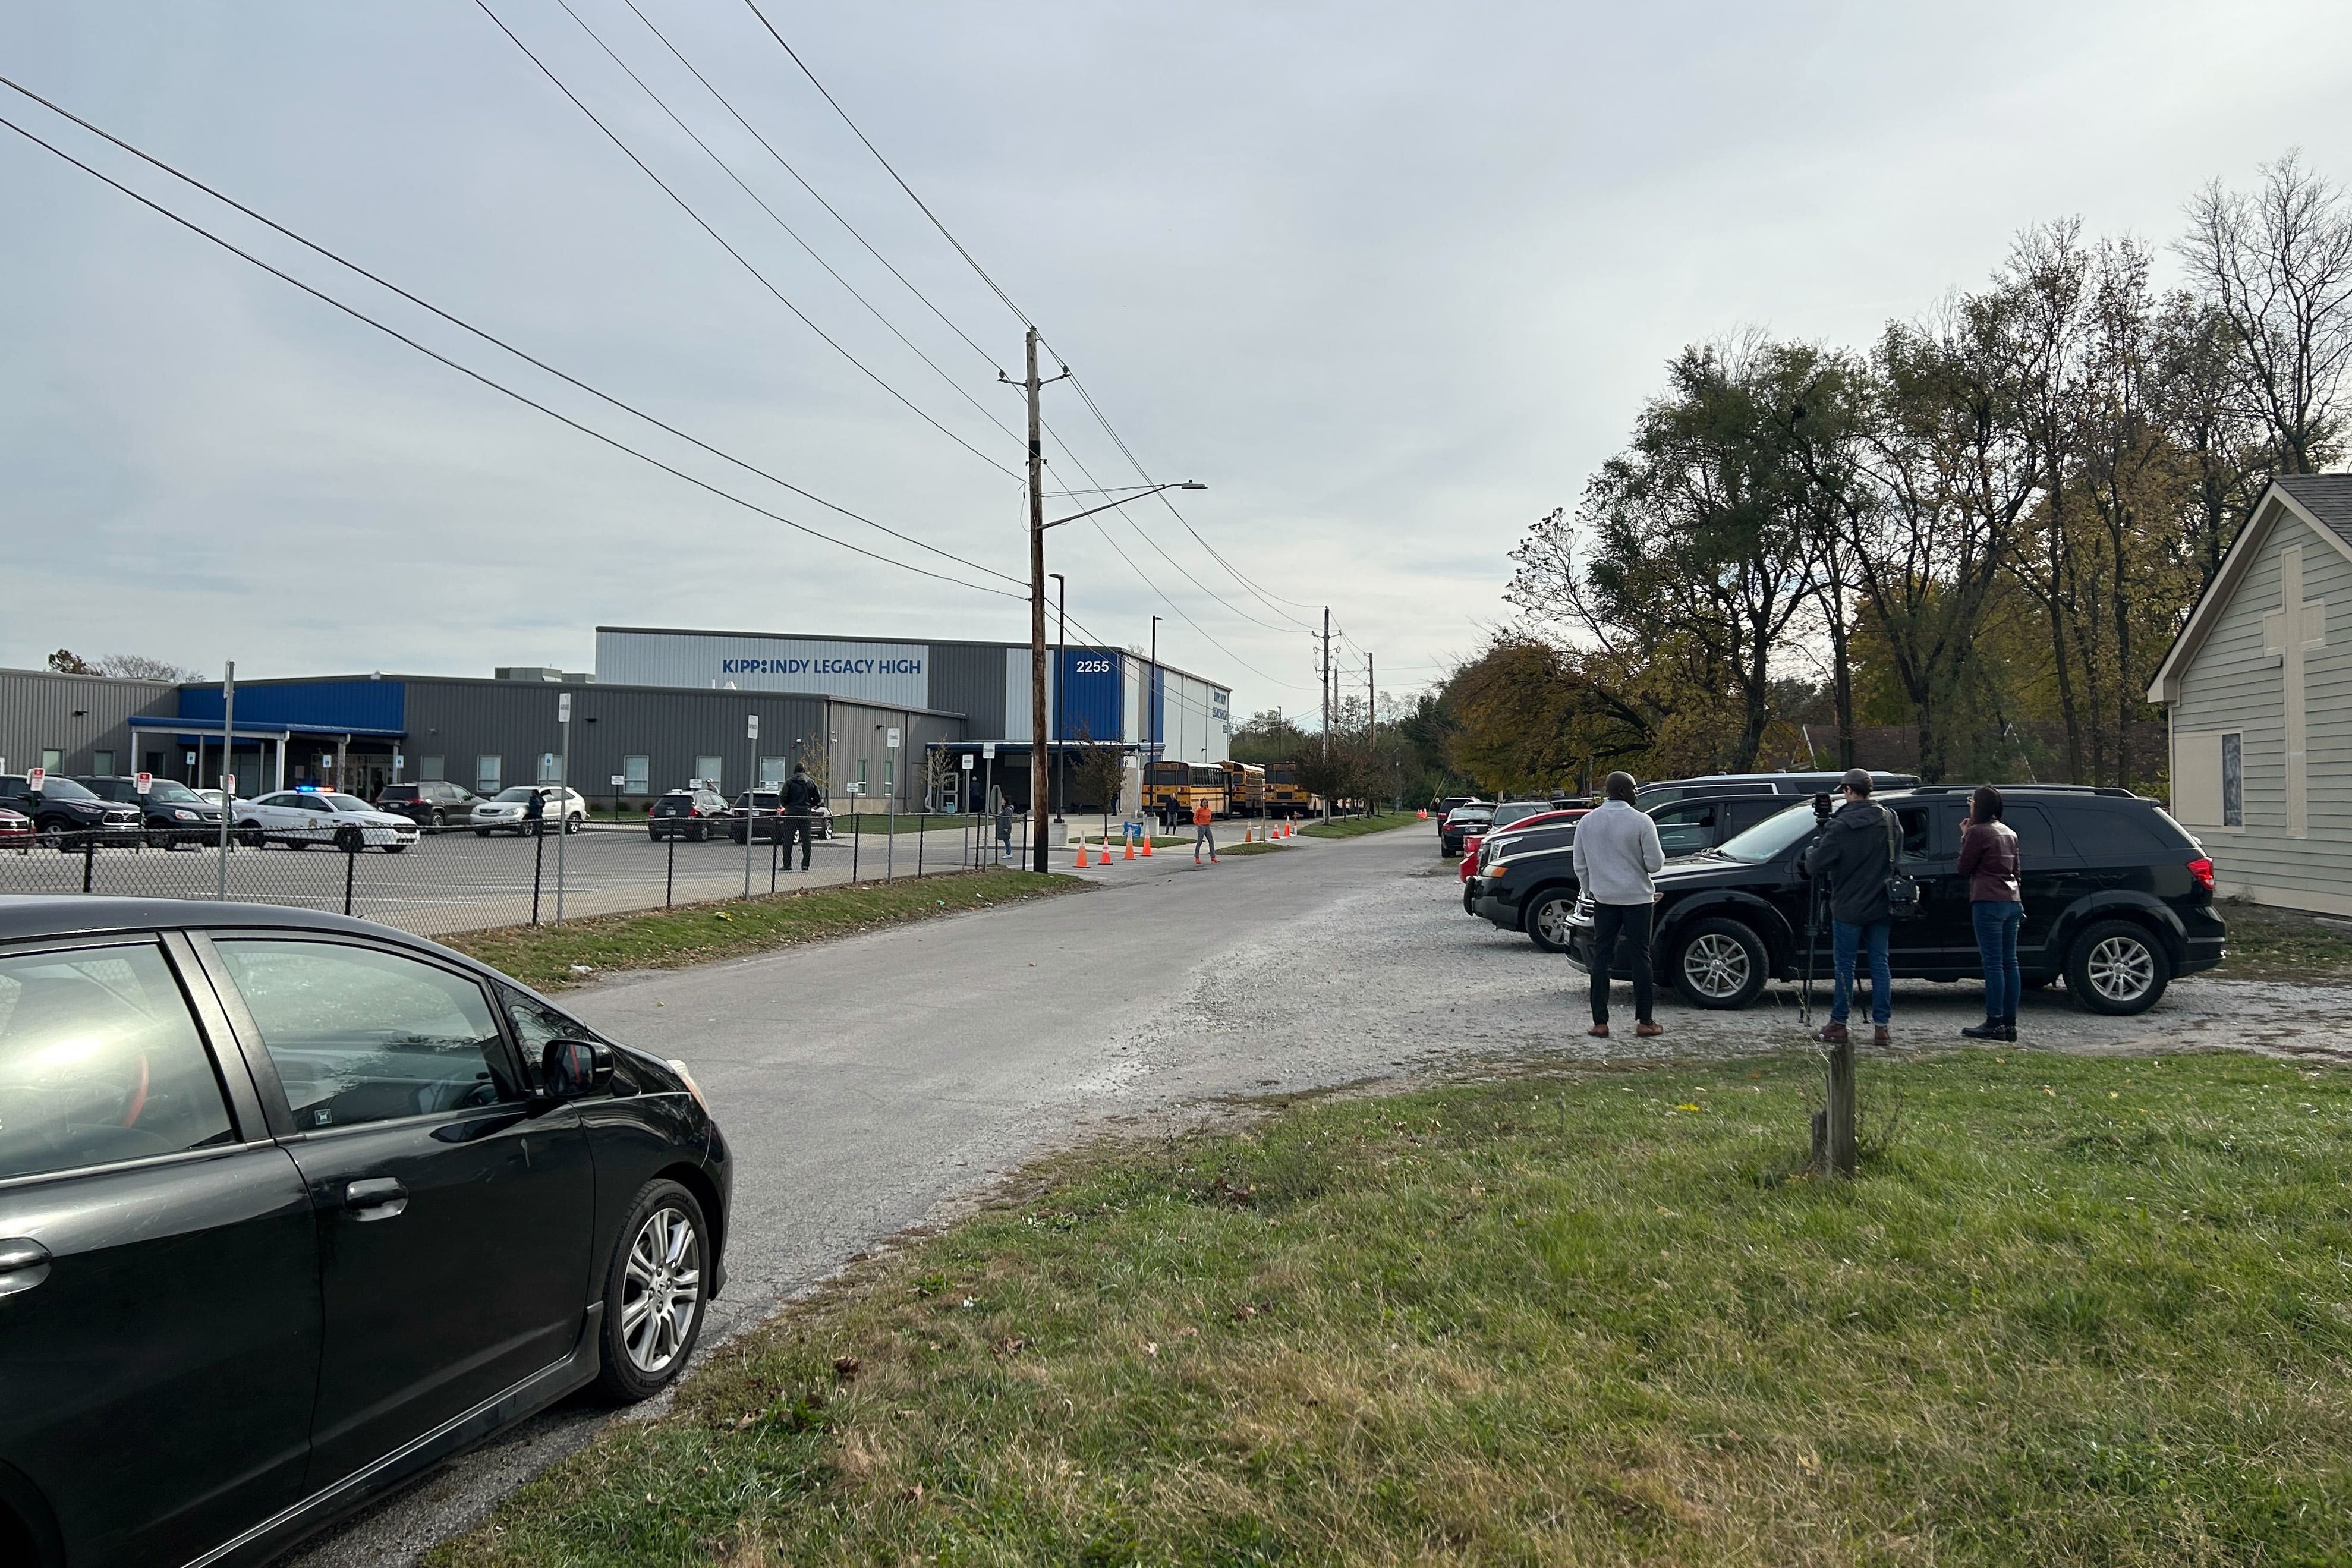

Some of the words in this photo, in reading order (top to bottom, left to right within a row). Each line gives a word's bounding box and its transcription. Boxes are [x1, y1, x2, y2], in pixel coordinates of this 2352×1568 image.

[770, 659, 810, 673] INDY
[814, 659, 874, 673] LEGACY
[879, 659, 921, 674] HIGH
[1076, 660, 1109, 673] 2255
